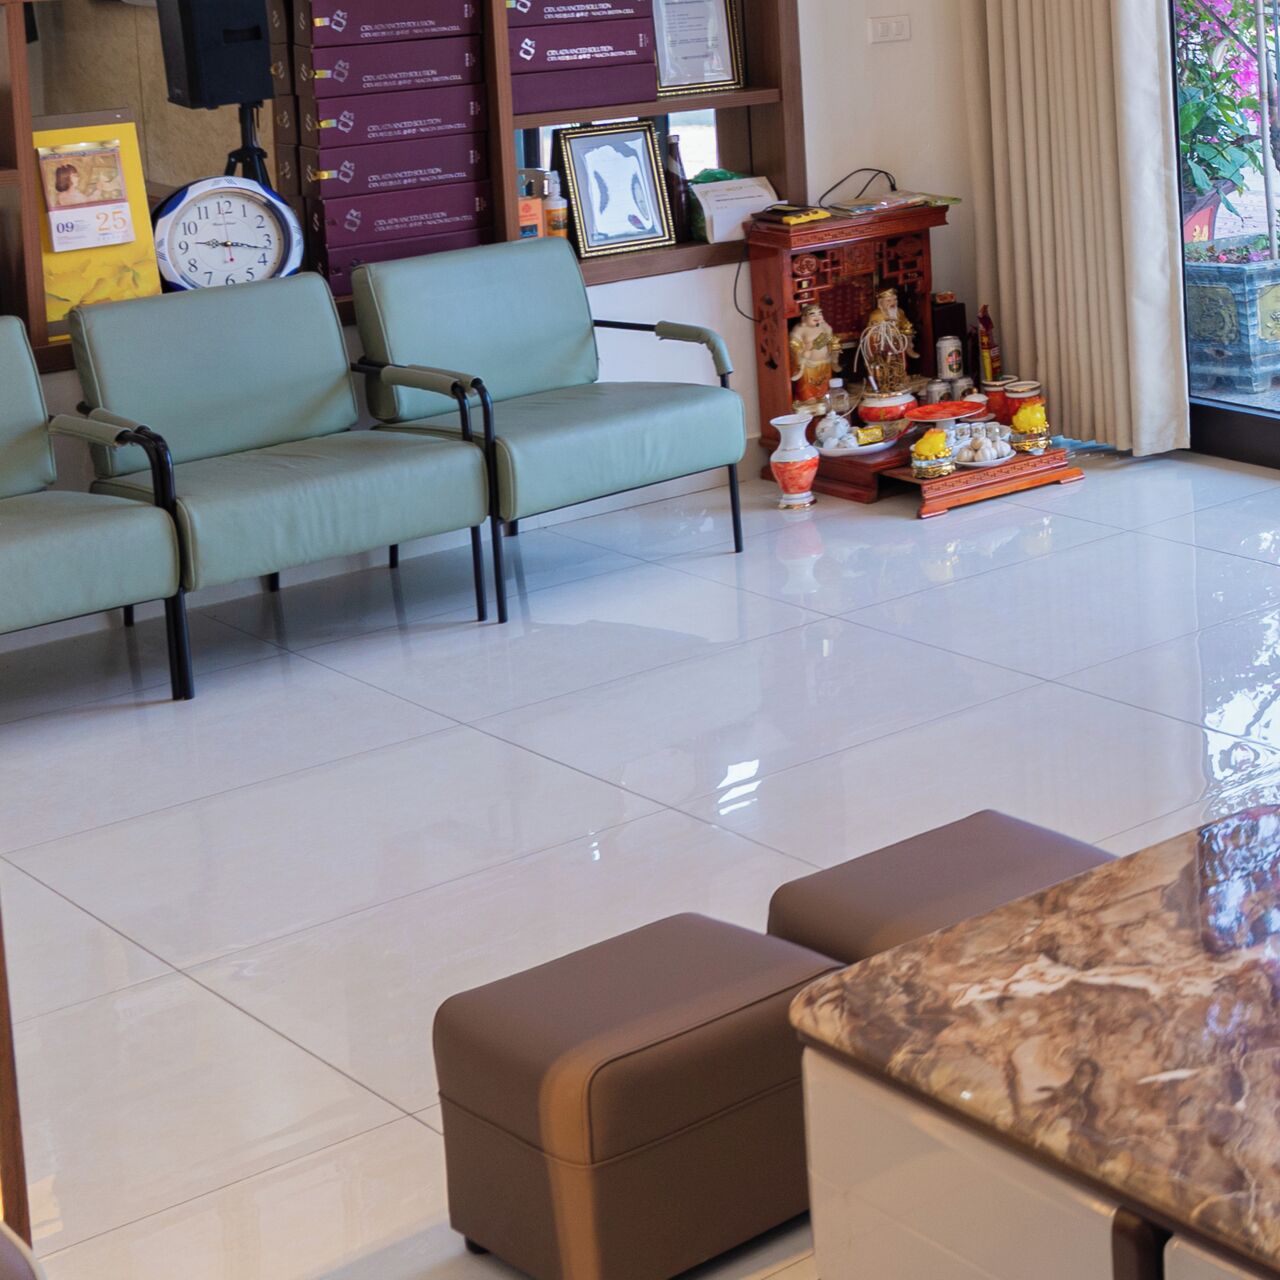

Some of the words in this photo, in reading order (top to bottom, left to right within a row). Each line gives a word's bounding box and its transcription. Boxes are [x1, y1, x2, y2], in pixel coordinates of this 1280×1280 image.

[556, 4, 586, 12] ADVANCED
[586, 2, 612, 10] SOLUTION
[558, 47, 588, 55] ADVANCED
[588, 45, 613, 53] SOLUTION
[197, 206, 209, 219] 11
[216, 200, 233, 214] 12
[241, 204, 247, 218] 1
[56, 222, 74, 234] 09
[96, 210, 127, 232] 25
[182, 221, 198, 235] 10
[255, 215, 265, 228] 2
[178, 241, 189, 255] 9
[263, 234, 272, 248] 3
[188, 258, 199, 272] 8
[257, 252, 268, 265] 4
[204, 271, 214, 285] 7
[225, 272, 235, 286] 6
[245, 267, 255, 281] 5
